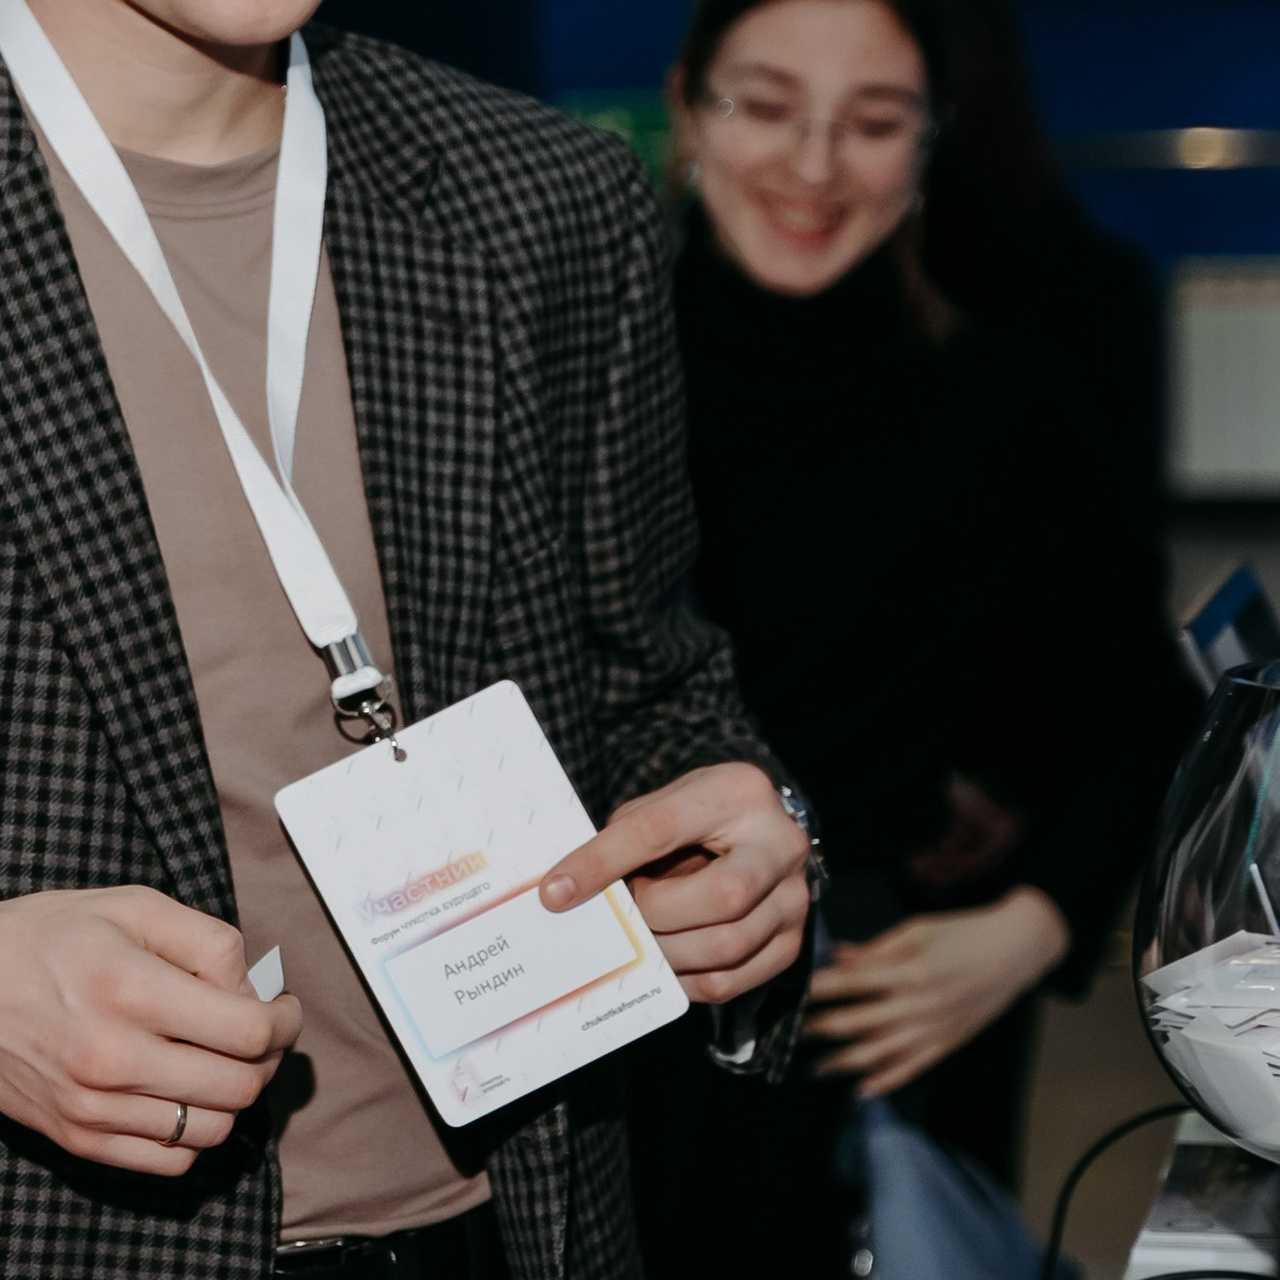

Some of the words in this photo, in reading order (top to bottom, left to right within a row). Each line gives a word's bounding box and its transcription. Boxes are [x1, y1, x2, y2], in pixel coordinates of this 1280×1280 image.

[356, 854, 487, 920] Участник
[444, 934, 510, 980] Андрей
[454, 963, 525, 1005] Рындин
[581, 987, 662, 1031] chukotkaforum.ru
